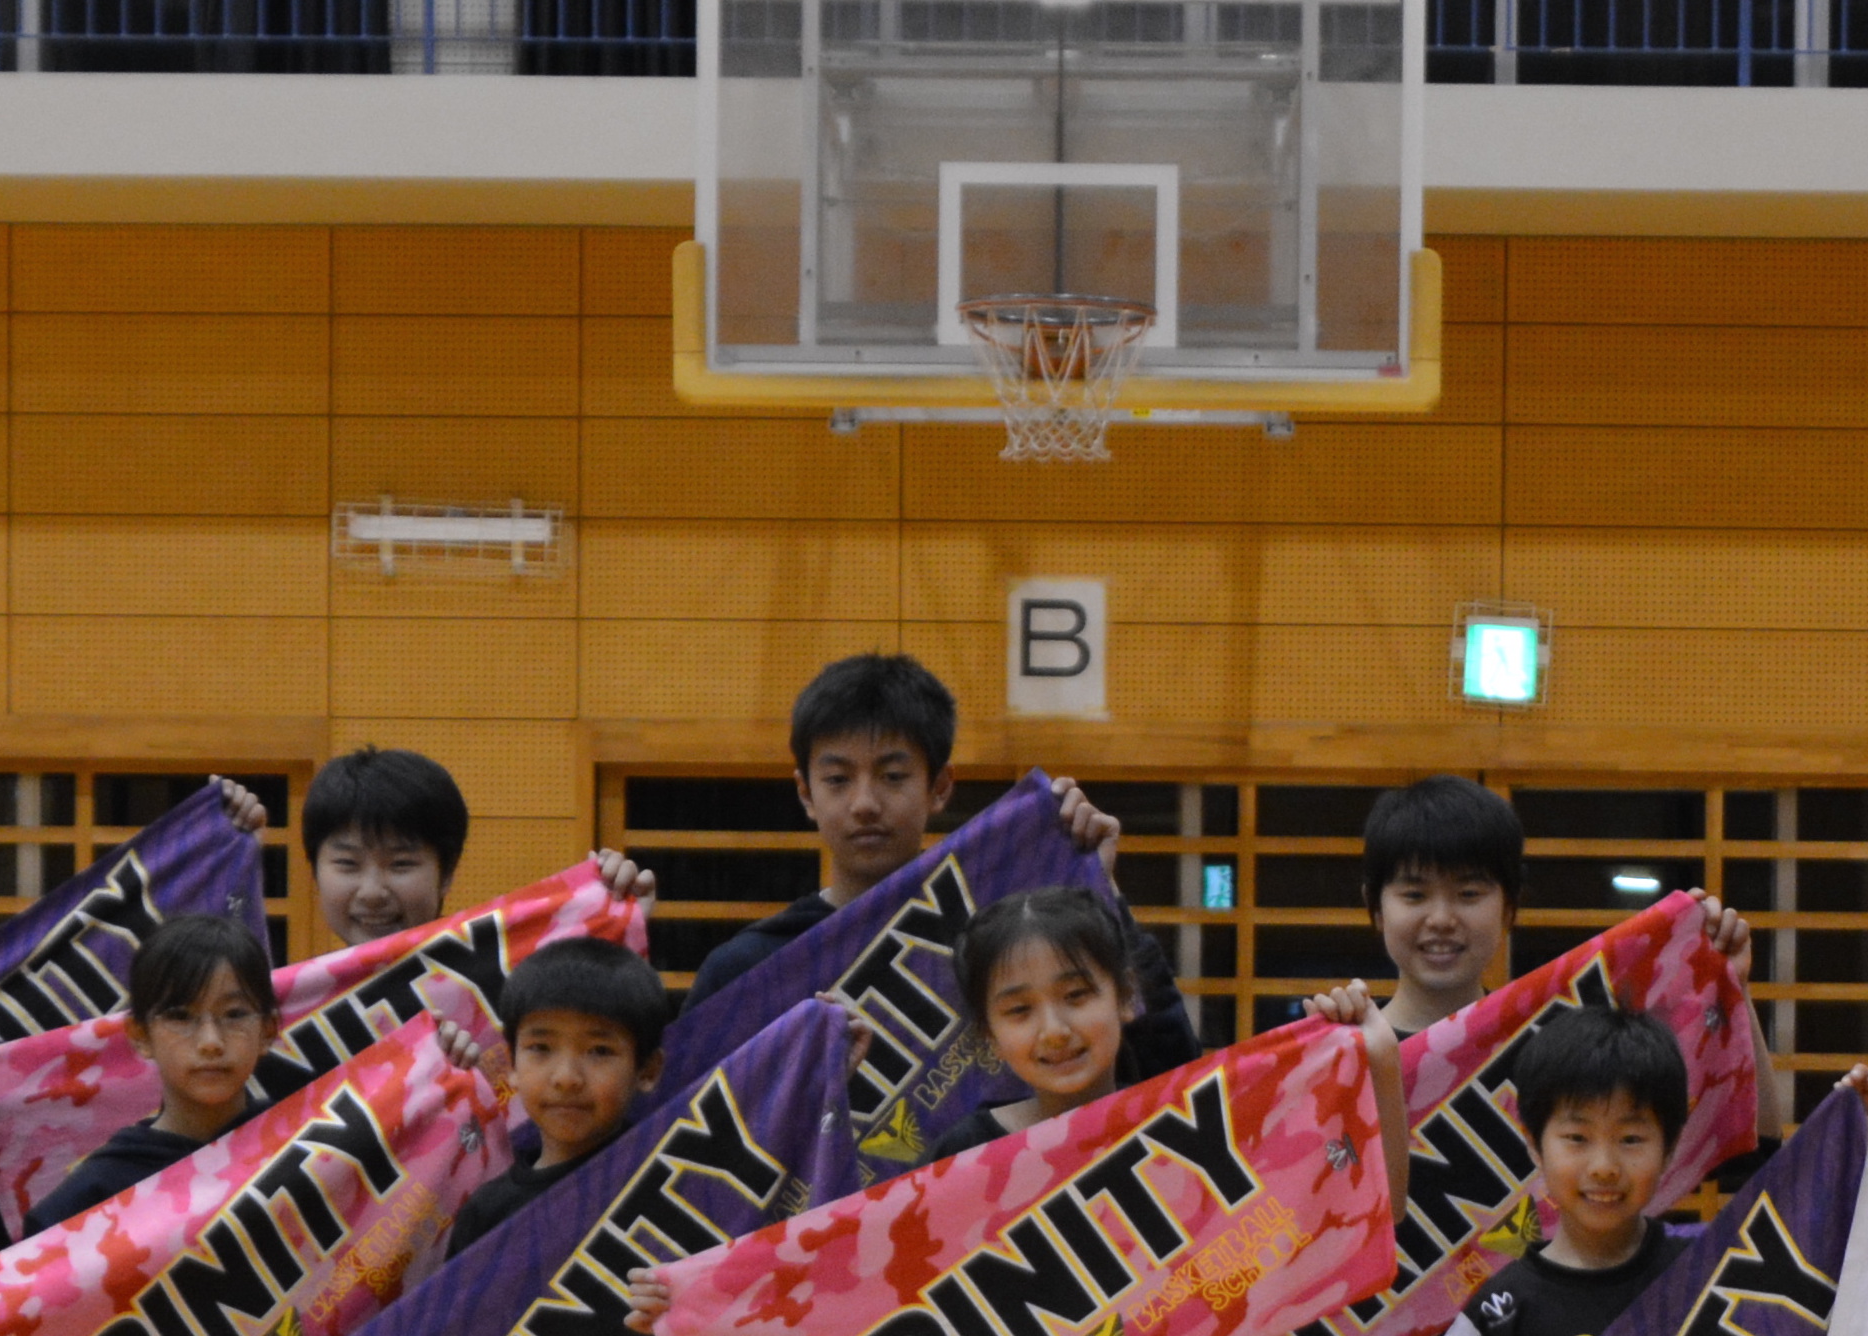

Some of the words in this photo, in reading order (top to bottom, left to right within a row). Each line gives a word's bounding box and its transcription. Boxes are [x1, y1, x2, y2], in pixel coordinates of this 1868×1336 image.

[1020, 599, 1091, 677] B
[307, 1180, 439, 1325] BASKETBALL
[365, 1214, 455, 1297] SCHOOL
[1126, 1194, 1297, 1333] BASKETBALL
[1201, 1220, 1314, 1313] SCHOOL
